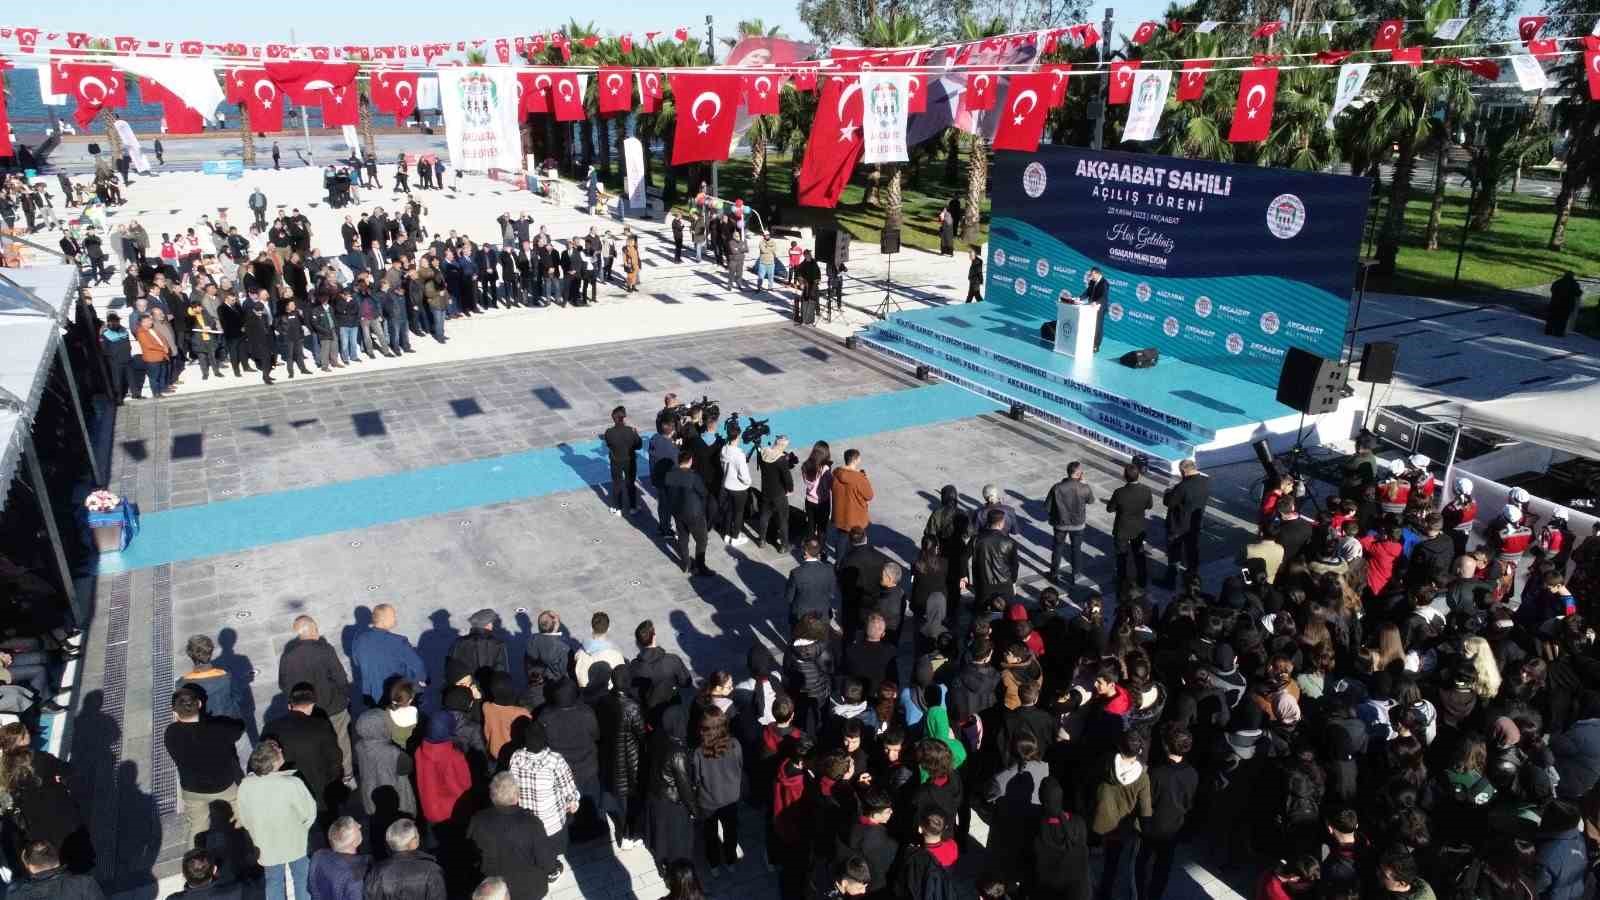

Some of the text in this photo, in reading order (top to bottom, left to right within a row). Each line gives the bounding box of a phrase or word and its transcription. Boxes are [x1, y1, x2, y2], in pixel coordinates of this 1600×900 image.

[1075, 159, 1167, 187] AKÇAABAT
[1168, 169, 1232, 196] SAHİLİ
[1092, 186, 1204, 212] AÇILIŞ TÖRENİ
[1125, 422, 1147, 438] PARK
